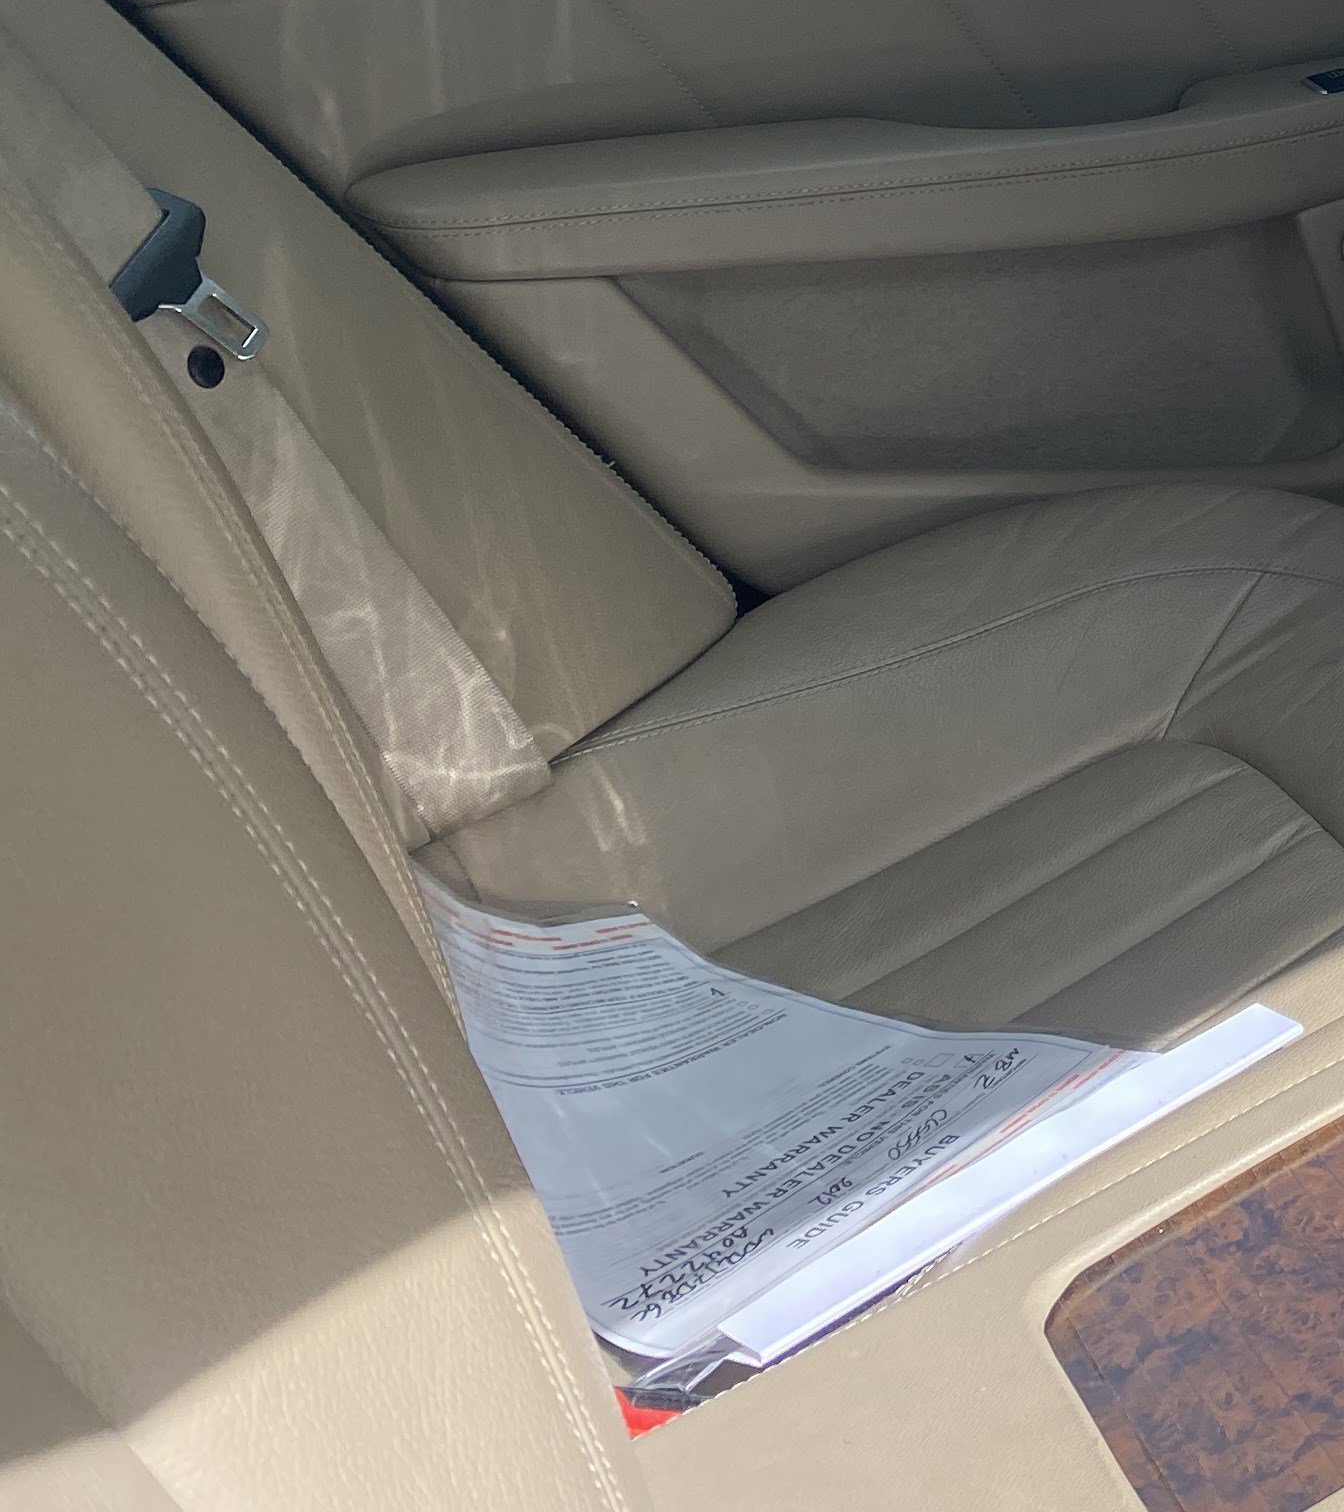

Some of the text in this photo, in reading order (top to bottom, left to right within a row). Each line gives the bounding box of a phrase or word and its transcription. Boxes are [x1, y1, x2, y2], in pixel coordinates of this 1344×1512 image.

[840, 1072, 925, 1123] DEALER
[856, 1121, 890, 1142] NO
[722, 1126, 844, 1198] WARRANTY
[766, 1145, 856, 1198] DEALER
[786, 1134, 960, 1250] BUYERS GUIDE
[808, 1177, 853, 1207] 2012
[639, 1201, 770, 1276] WARRANTY
